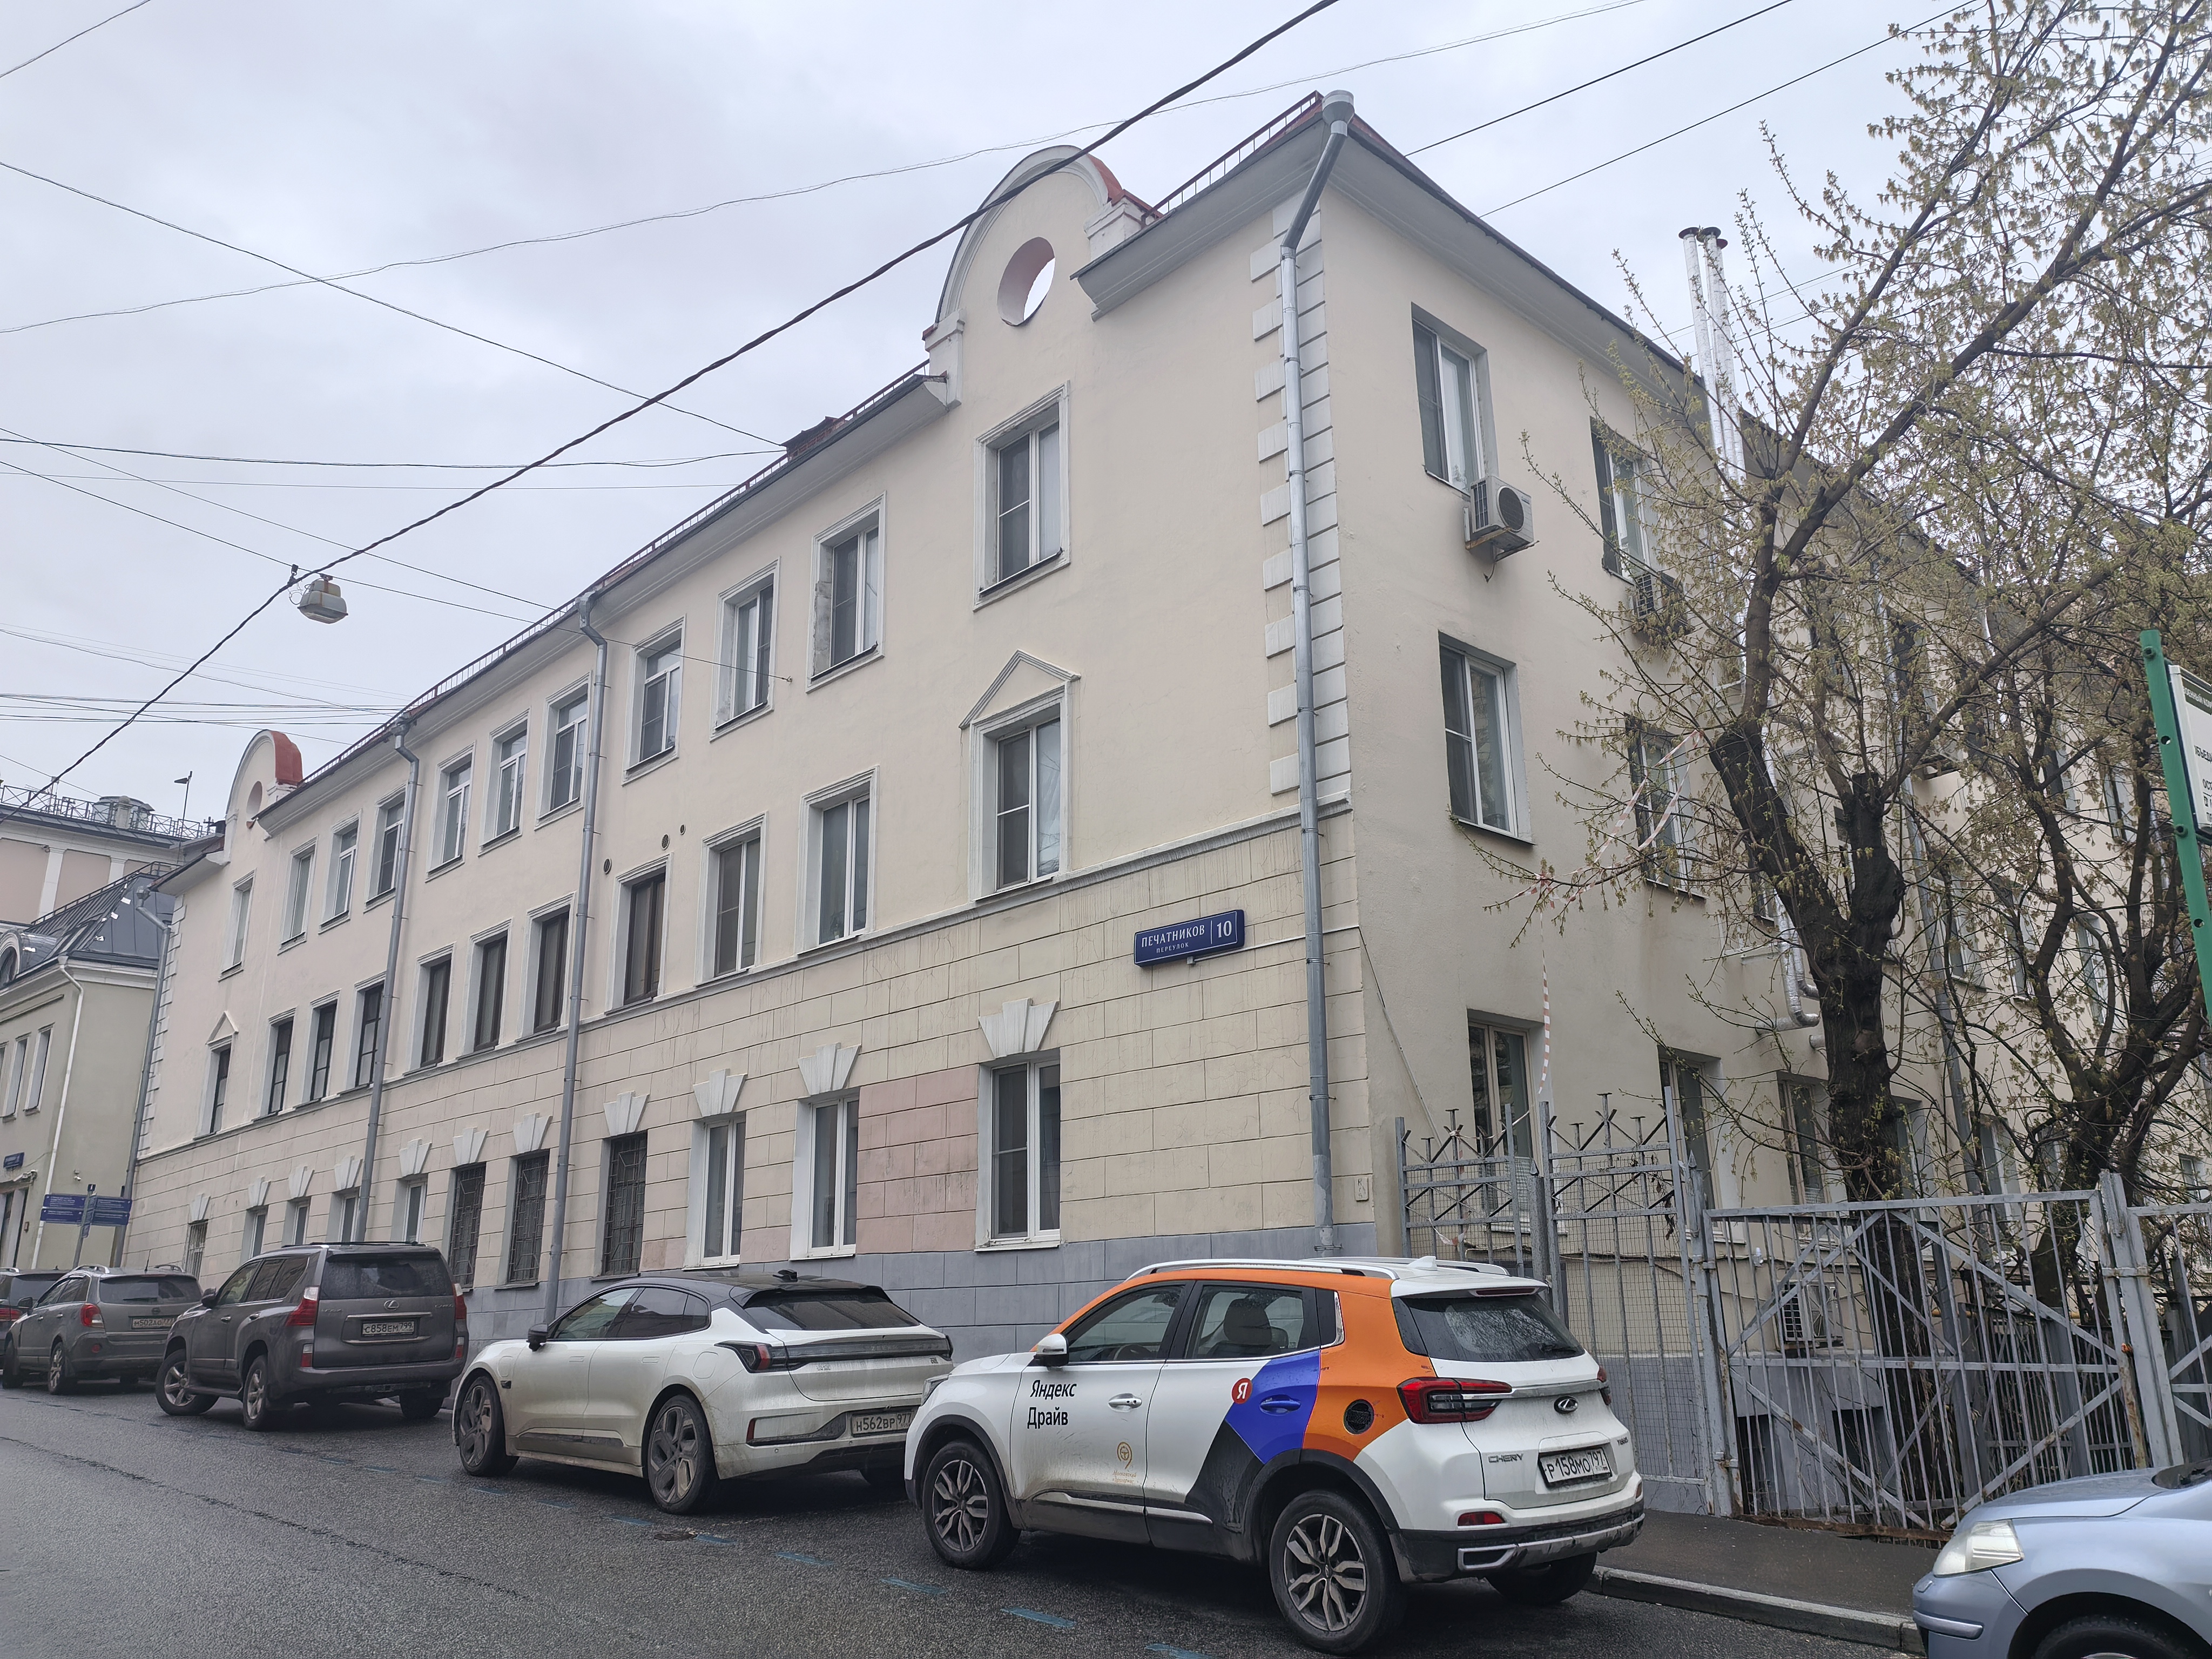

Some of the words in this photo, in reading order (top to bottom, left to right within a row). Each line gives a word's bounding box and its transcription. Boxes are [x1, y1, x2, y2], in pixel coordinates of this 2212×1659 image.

[1141, 925, 1205, 947] ПЕЧАТНИКОВ
[1217, 920, 1232, 938] 10
[1156, 942, 1189, 953] ПЕРЕУЛОК
[1030, 1379, 1077, 1400] Яндекс
[1237, 1382, 1248, 1399] Я
[1027, 1406, 1068, 1429] Драйв
[1488, 1453, 1523, 1463] CHERY
